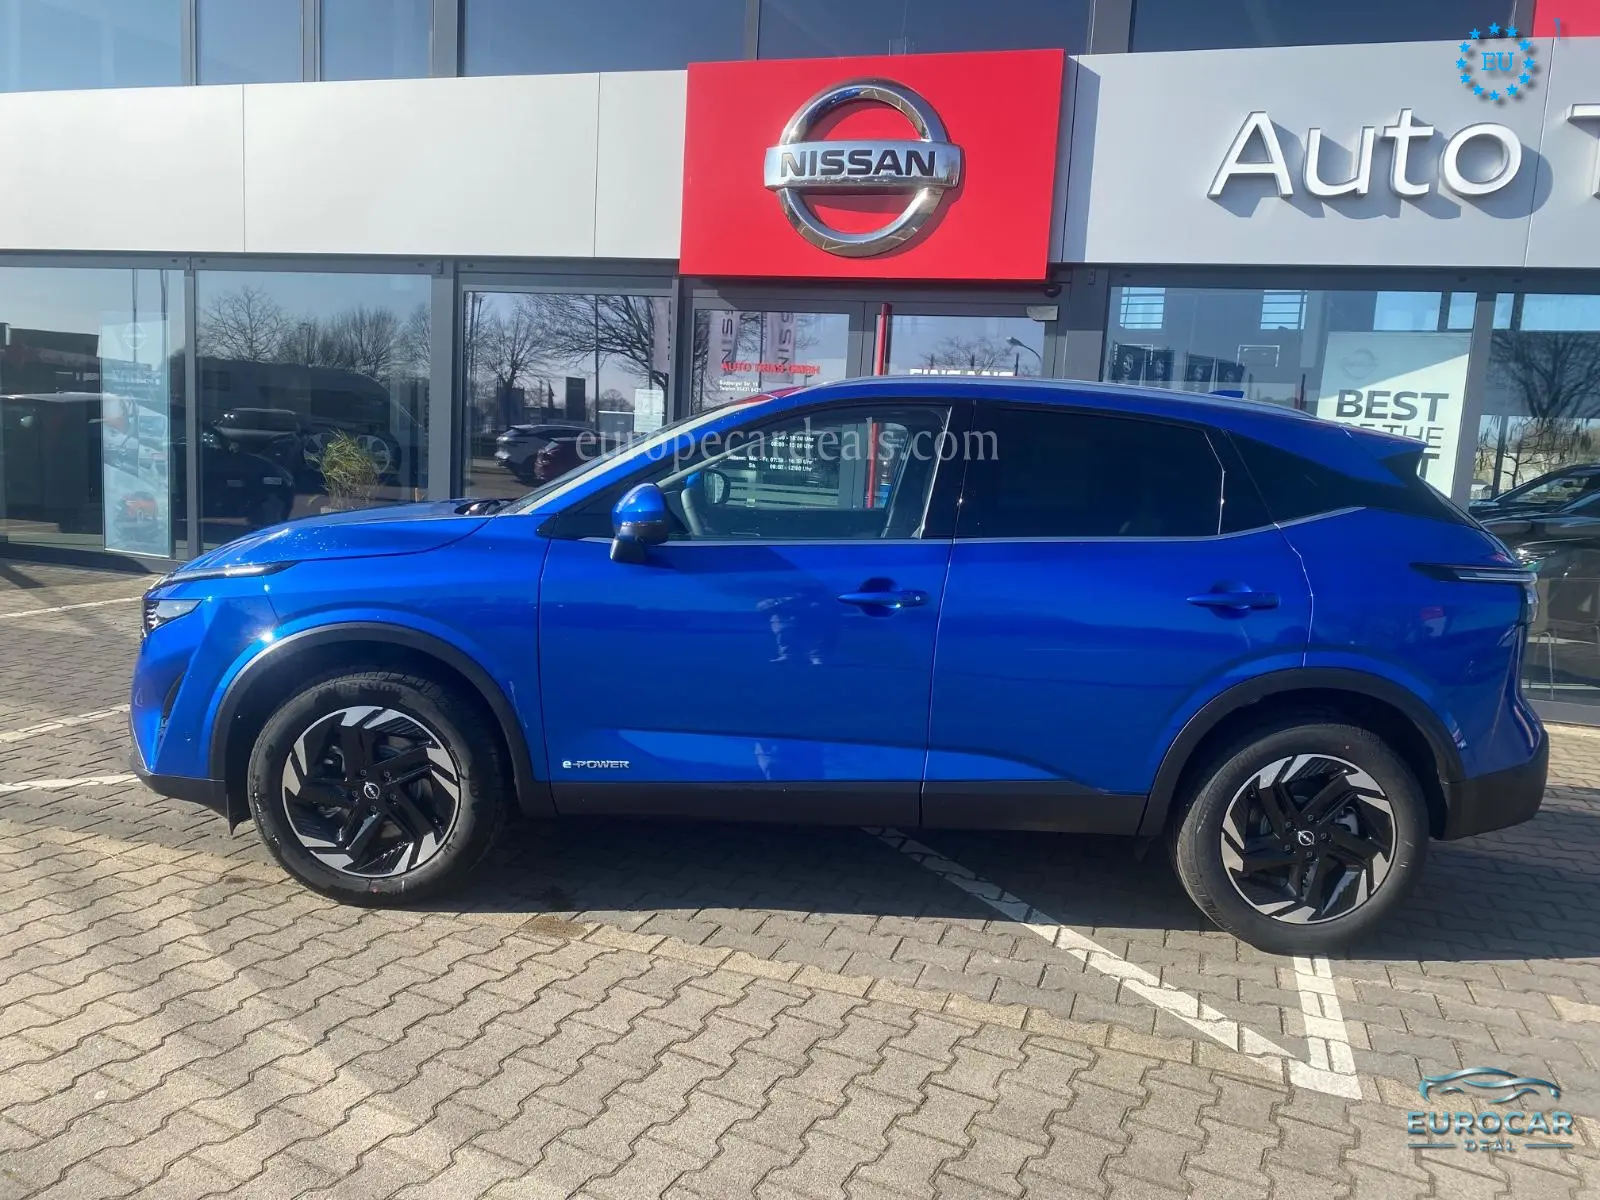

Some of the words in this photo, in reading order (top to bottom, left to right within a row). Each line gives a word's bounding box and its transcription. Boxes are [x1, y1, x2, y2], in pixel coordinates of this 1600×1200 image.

[780, 149, 936, 178] NISSAN
[1206, 108, 1522, 200] Auto
[1336, 389, 1450, 422] BEST
[562, 759, 630, 769] e-POWER
